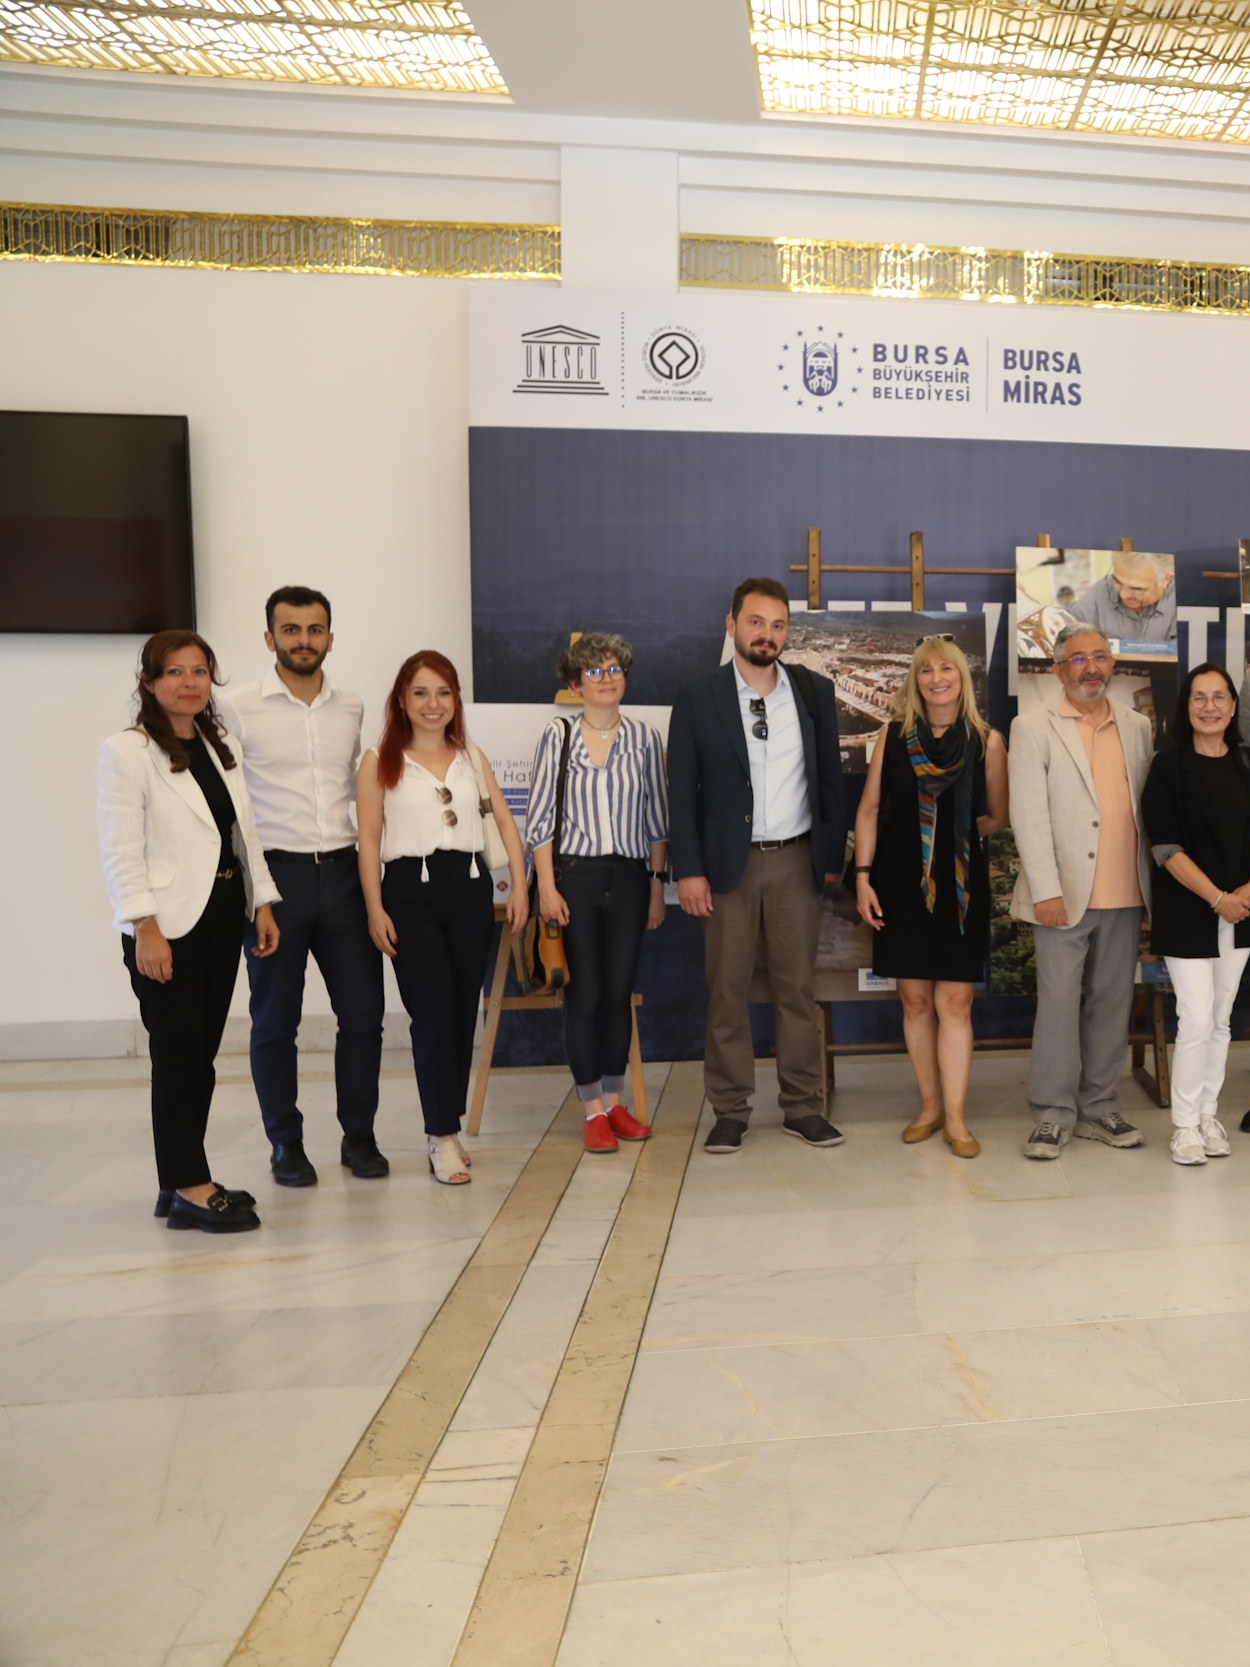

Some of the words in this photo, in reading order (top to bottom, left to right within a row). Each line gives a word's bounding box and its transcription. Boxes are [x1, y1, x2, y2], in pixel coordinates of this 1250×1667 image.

[526, 345, 597, 380] UNESCO
[873, 343, 969, 366] BURSA
[1003, 348, 1082, 374] BURSA
[873, 365, 969, 384] BÜYÜKŞEHİR
[873, 383, 970, 402] BELEDİYESİ
[1003, 374, 1082, 406] MİRAS
